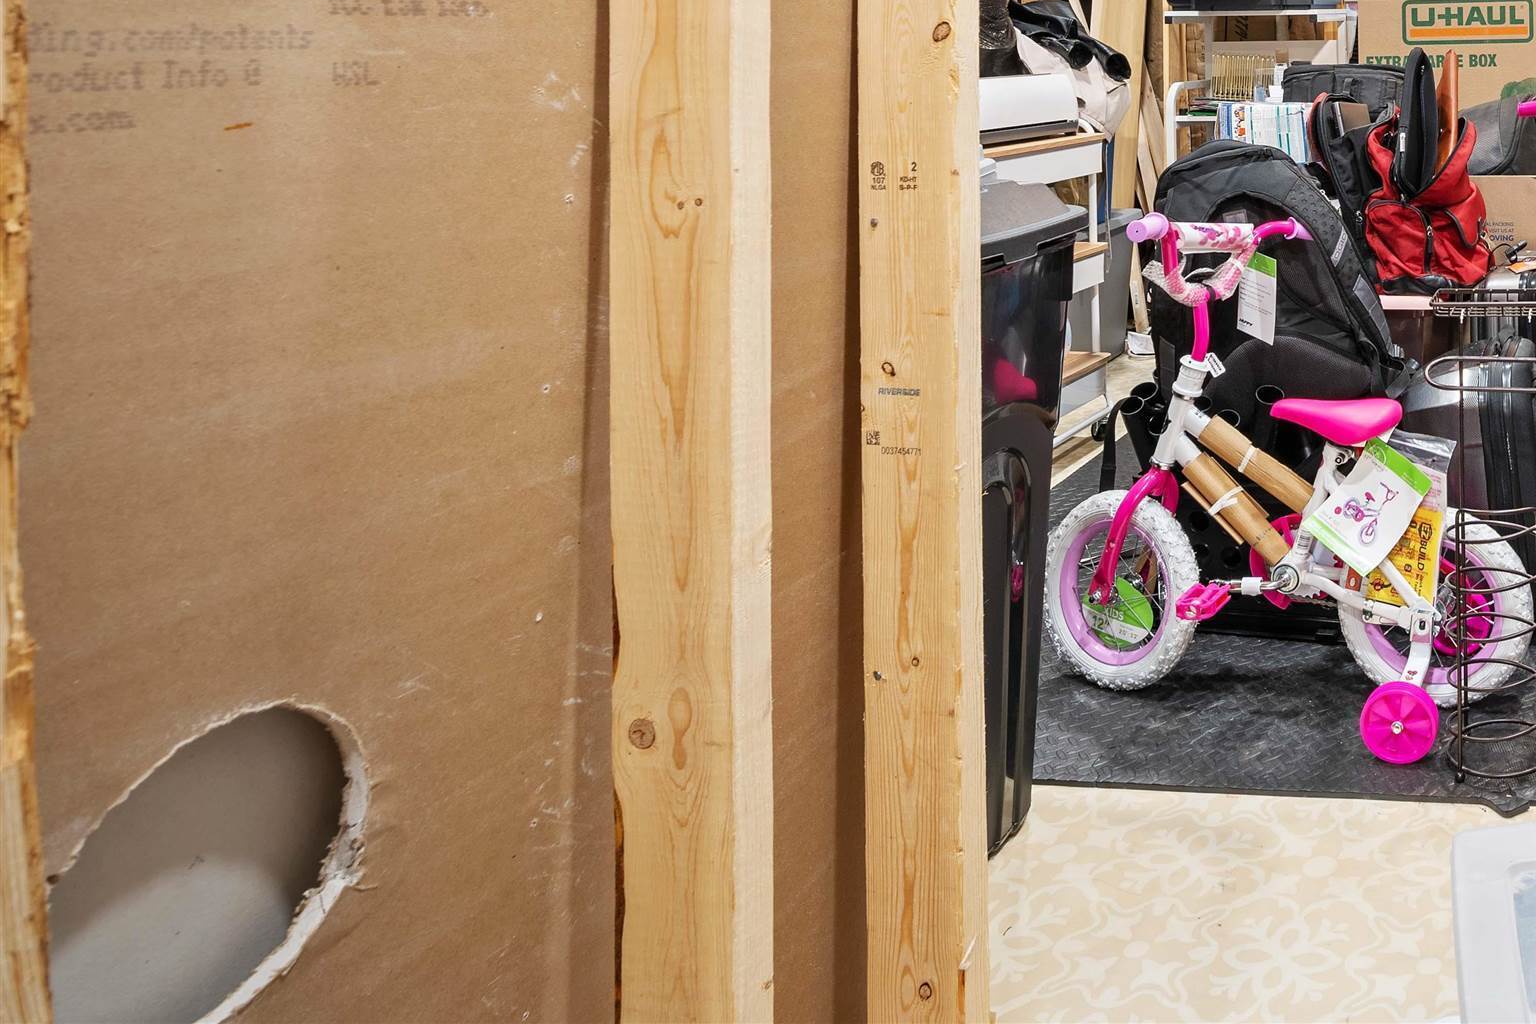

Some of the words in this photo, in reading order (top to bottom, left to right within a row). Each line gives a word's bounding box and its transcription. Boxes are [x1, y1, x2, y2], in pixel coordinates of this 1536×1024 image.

[1468, 54, 1497, 68] BOX
[27, 62, 144, 93] roduct
[911, 161, 917, 172] 2
